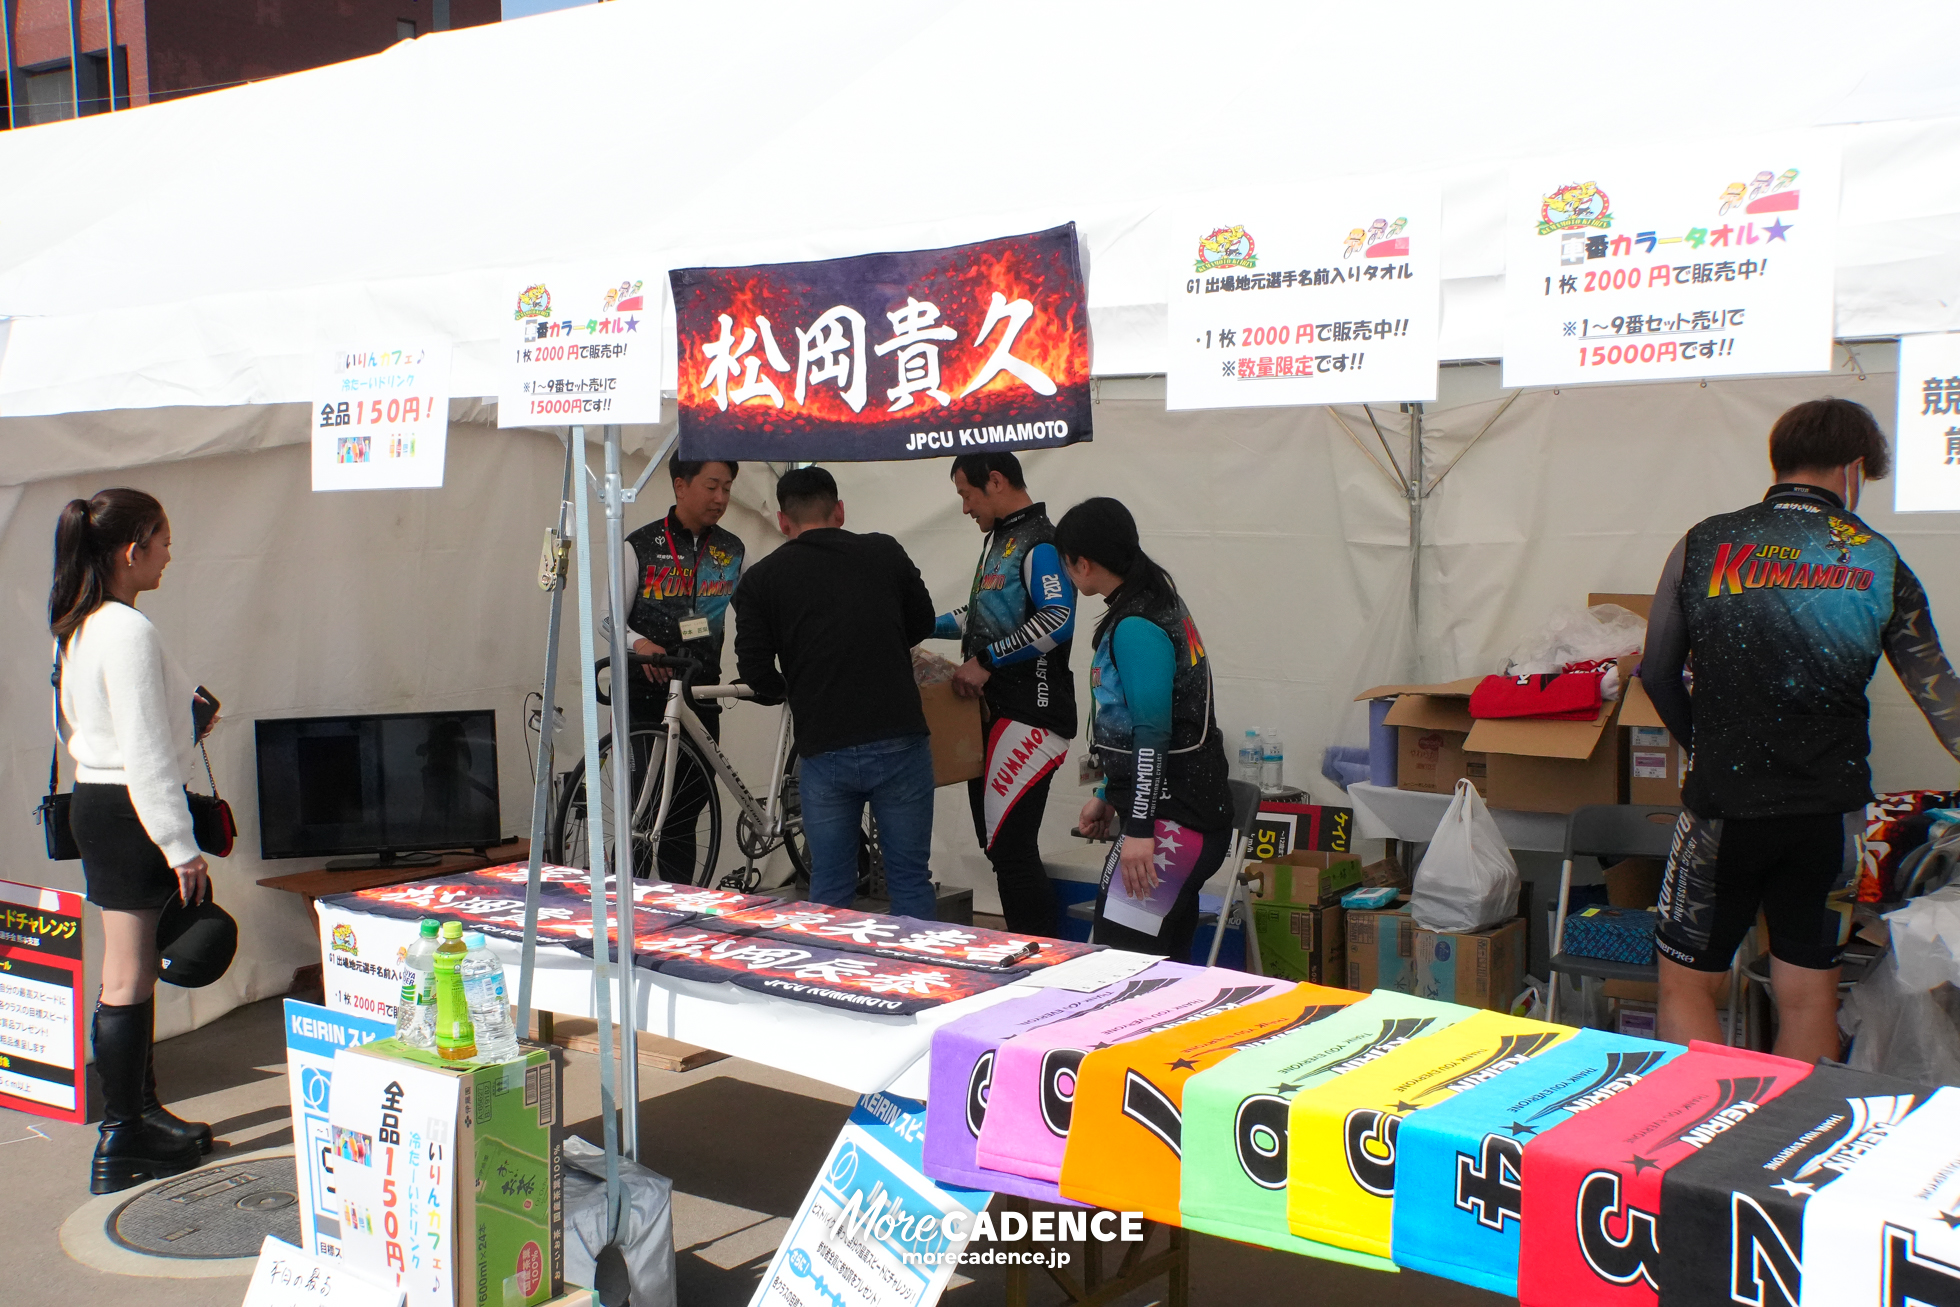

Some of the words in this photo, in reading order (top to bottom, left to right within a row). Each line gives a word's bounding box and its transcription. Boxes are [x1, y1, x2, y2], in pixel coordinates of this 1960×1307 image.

[1583, 267, 1642, 293] 2000
[701, 291, 1058, 413] 松岡貴久
[1242, 326, 1290, 347] 2000
[535, 346, 564, 362] 2000
[906, 429, 954, 451] JPCU
[960, 420, 1069, 446] KUMAMOTO
[1755, 545, 1802, 560] JPCU
[1706, 542, 1875, 599] KUMAMOTO
[1037, 682, 1049, 707] CLUB
[1132, 748, 1155, 819] KUMAMOTO
[1257, 829, 1276, 859] 50
[354, 995, 376, 1012] 2000
[811, 987, 903, 1010] KUMAMOTO
[290, 1015, 346, 1046] KEIRIN
[860, 1092, 902, 1123] KEIRIN
[1563, 1072, 1642, 1115] KEIRIN
[1679, 1100, 1760, 1149] KEIRIN
[531, 1249, 539, 1284] 100%
